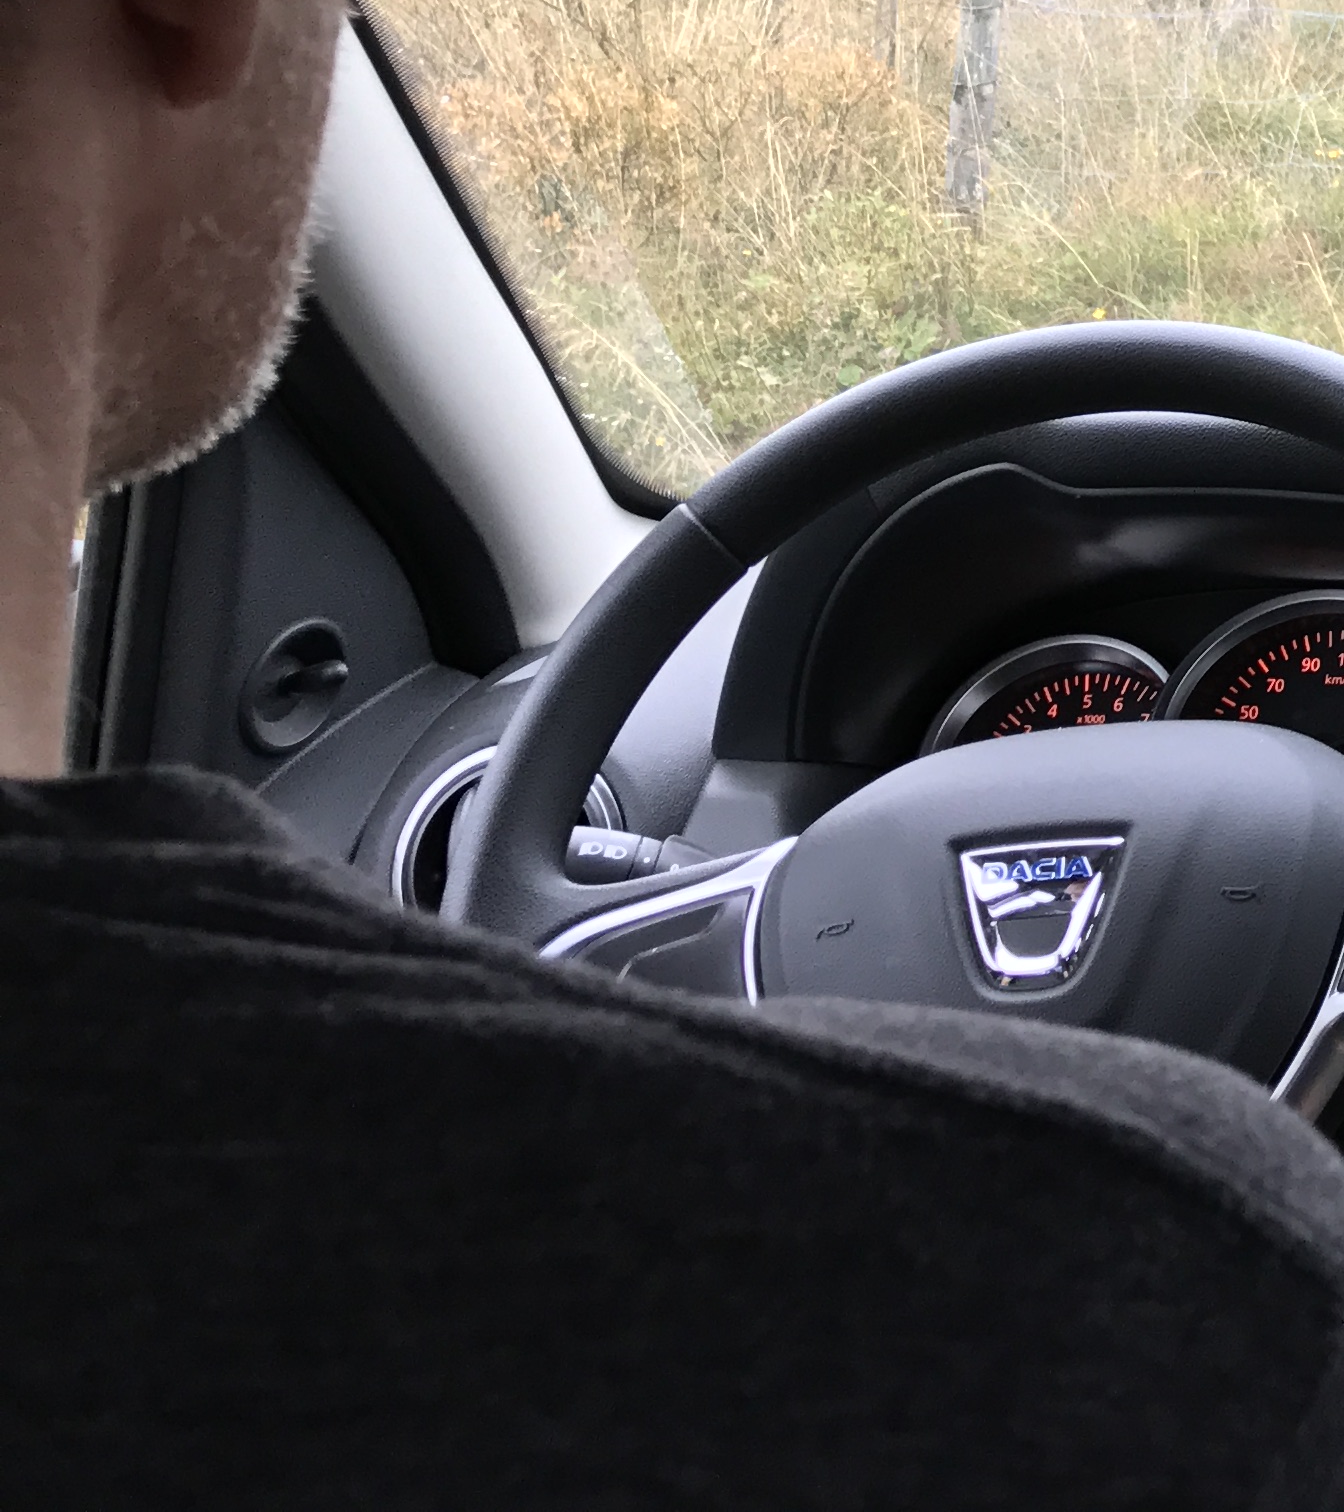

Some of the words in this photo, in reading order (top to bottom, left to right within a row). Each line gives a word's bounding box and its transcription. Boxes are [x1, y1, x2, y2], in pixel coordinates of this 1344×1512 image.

[1301, 658, 1321, 672] 90
[1266, 678, 1285, 693] 70
[1083, 694, 1093, 709] 5
[1113, 697, 1124, 712] 6
[1047, 704, 1058, 718] 4
[1239, 705, 1259, 720] 50
[983, 856, 1093, 882] DACIA
